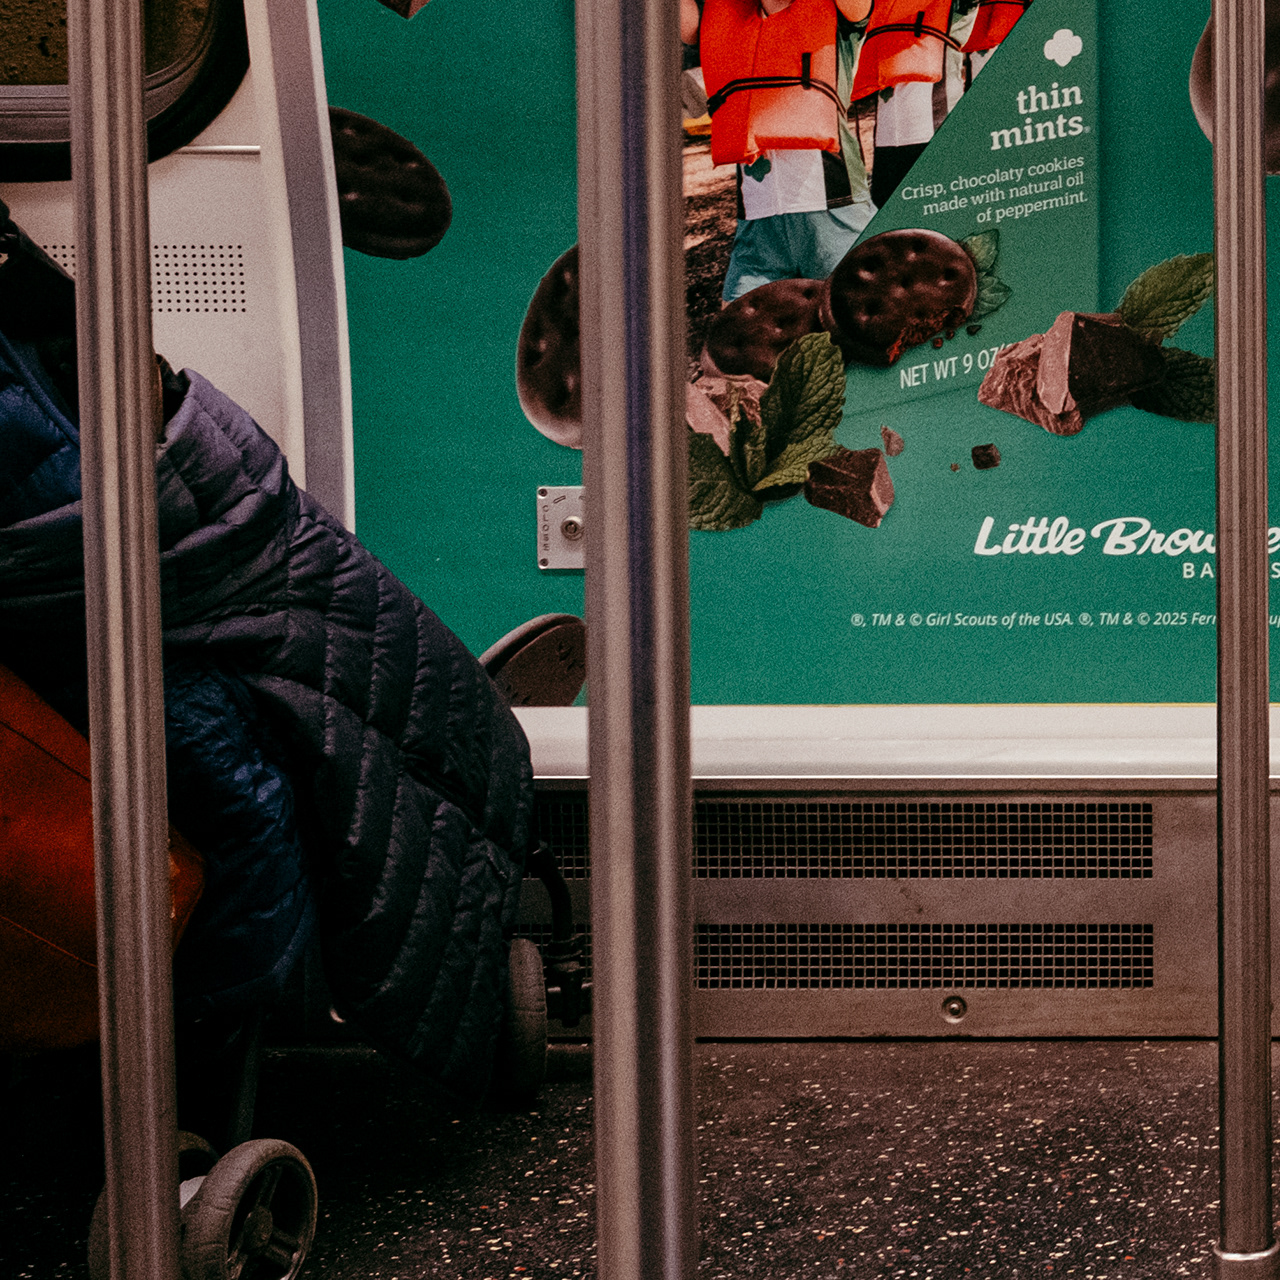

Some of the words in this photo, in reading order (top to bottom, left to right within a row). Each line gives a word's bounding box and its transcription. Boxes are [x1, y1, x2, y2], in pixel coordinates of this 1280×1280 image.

[1016, 82, 1083, 114] thin
[901, 182, 947, 201] Crisp,
[950, 167, 1024, 192] chocolaty
[1027, 156, 1085, 177] cookies
[923, 195, 968, 216] made
[970, 188, 1006, 206] with
[1008, 175, 1063, 199] natural
[1066, 171, 1085, 188] oil
[976, 208, 993, 223] of
[995, 191, 1088, 223] peppermint.
[900, 363, 930, 389] NET
[933, 356, 958, 381] WT
[962, 353, 973, 374] 9
[973, 516, 1086, 556] Little
[872, 613, 892, 626] TM
[895, 613, 905, 626] &
[926, 613, 951, 626] Girl
[954, 613, 998, 626] Scouts
[1001, 612, 1018, 629] of
[1019, 613, 1041, 626] the
[1044, 613, 1074, 626] USA.
[1099, 613, 1119, 626] TM
[1122, 613, 1133, 626] &
[1153, 613, 1188, 626] 2025
